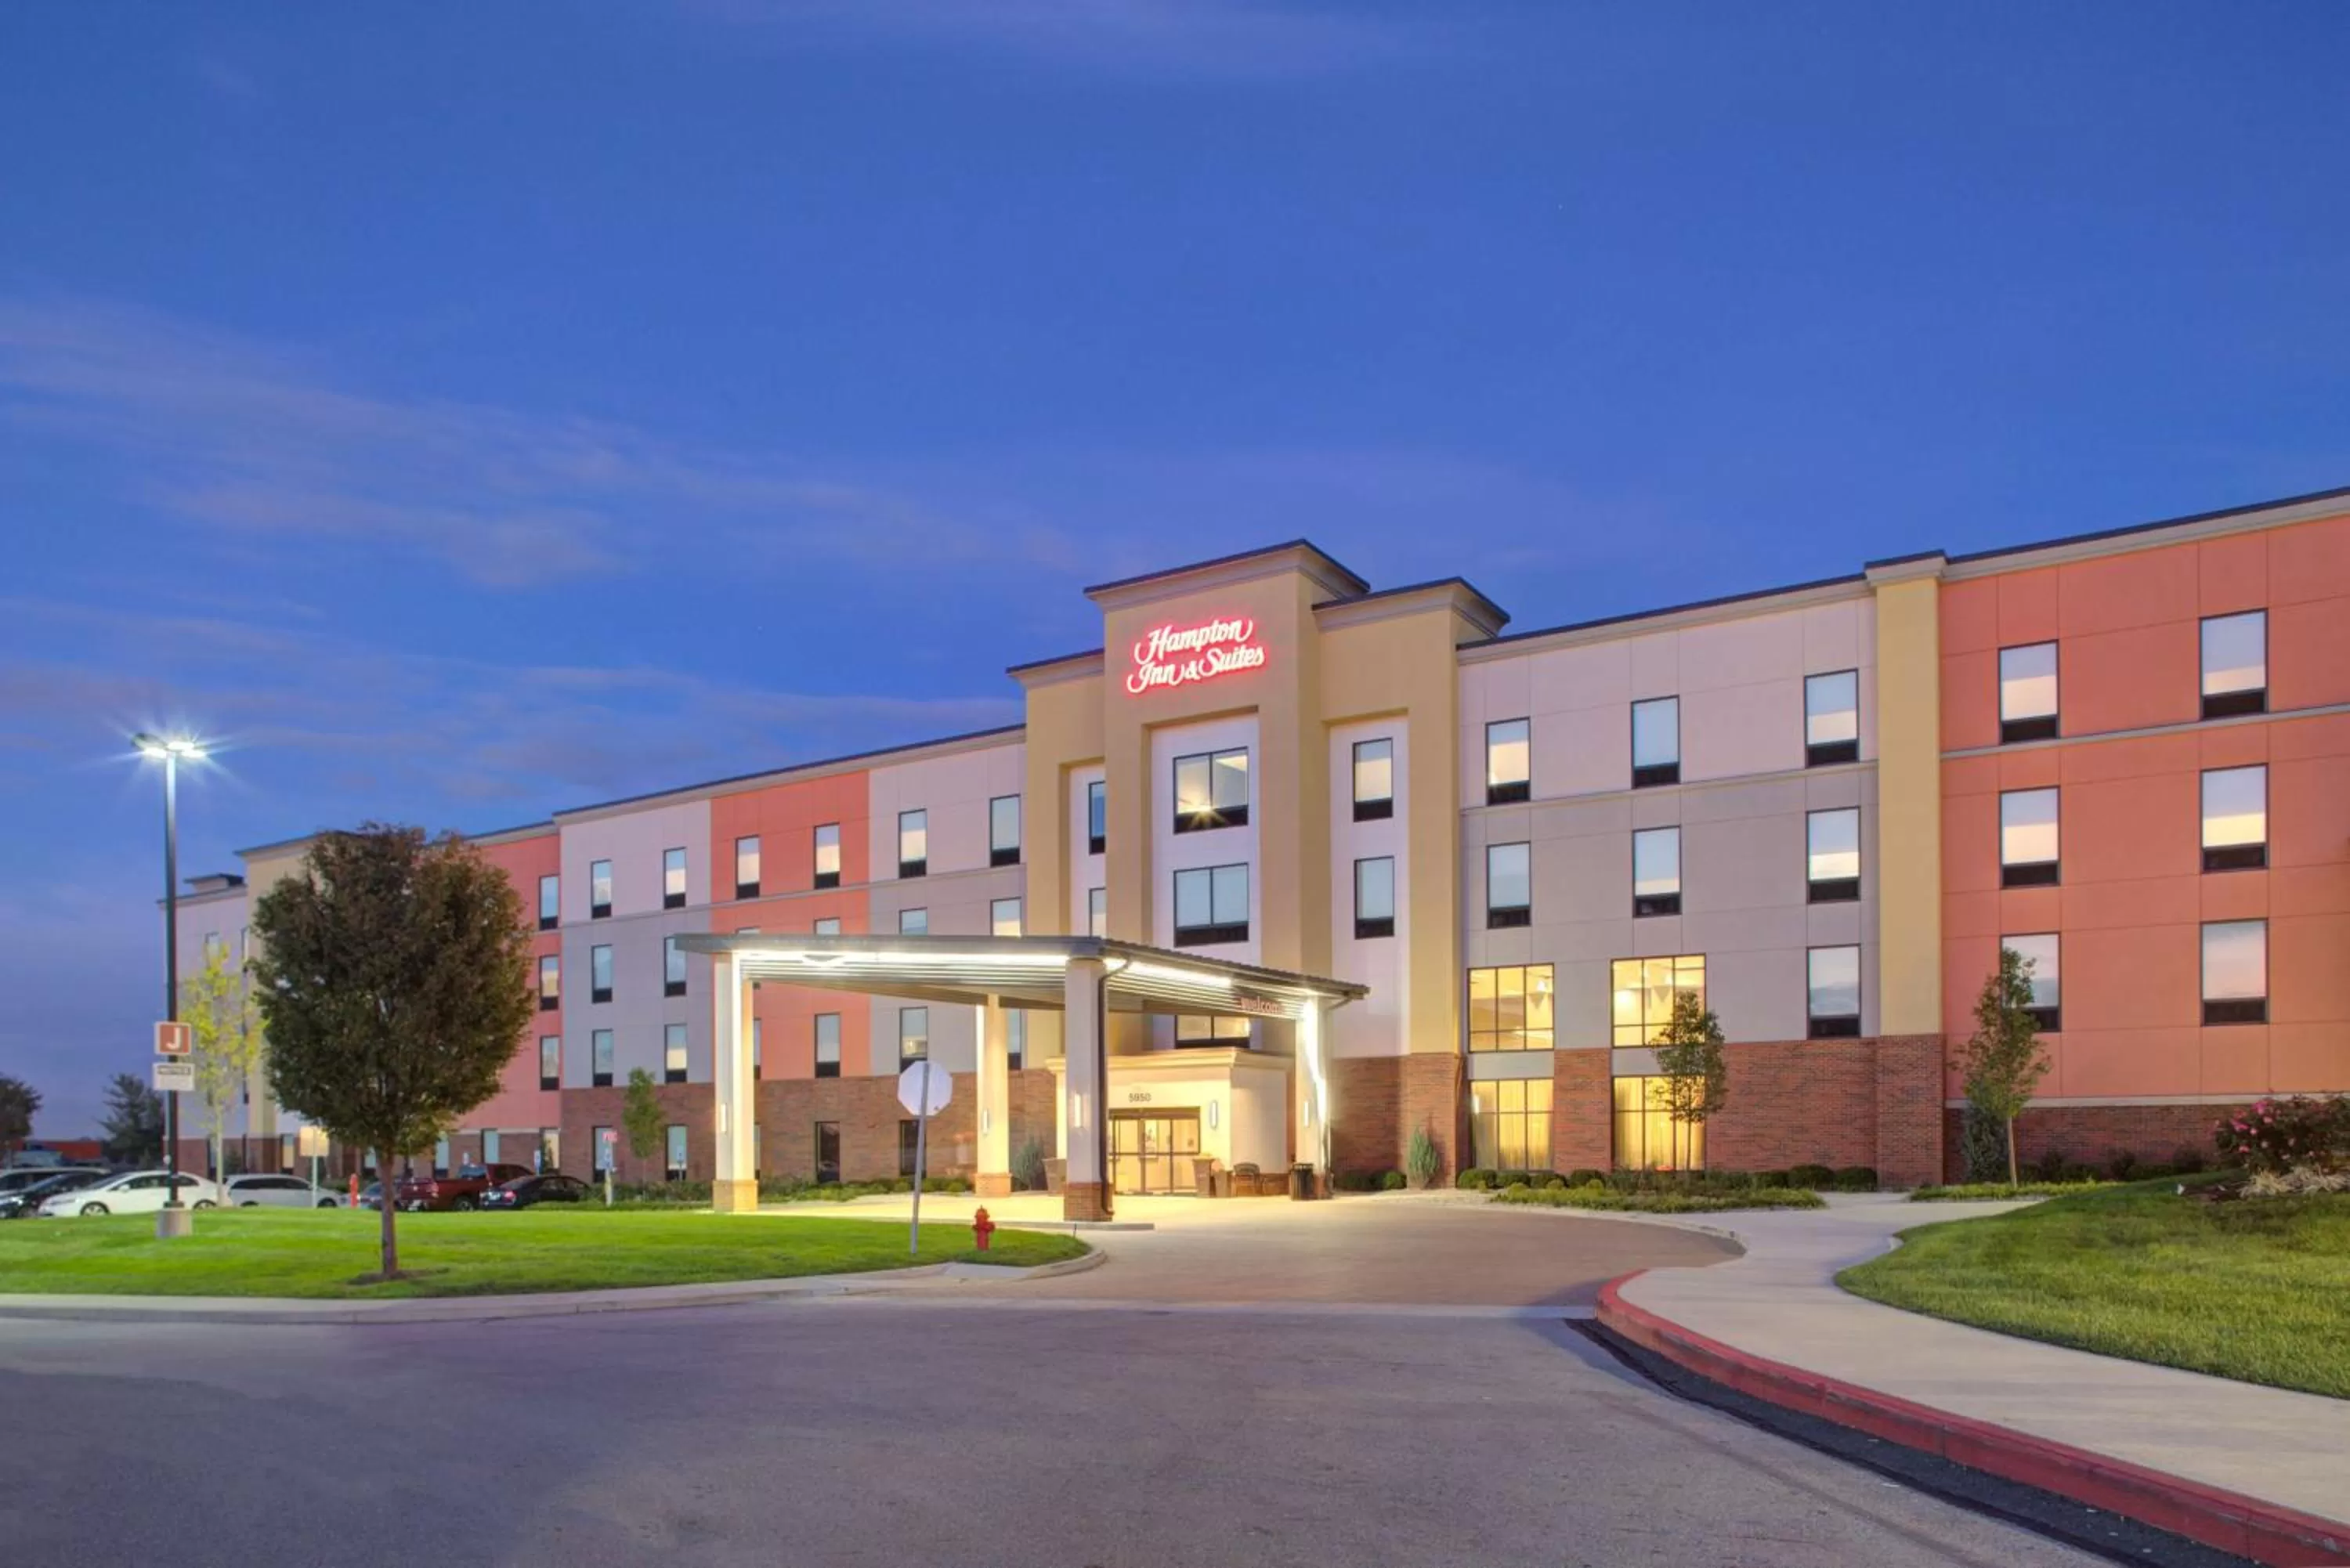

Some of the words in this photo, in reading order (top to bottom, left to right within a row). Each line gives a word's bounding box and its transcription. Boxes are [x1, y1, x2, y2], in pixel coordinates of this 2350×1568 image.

[1134, 620, 1253, 663] Hampton
[1126, 662, 1184, 693] Inn
[1184, 660, 1201, 681] &
[1198, 645, 1265, 677] Suites
[166, 1027, 181, 1050] J
